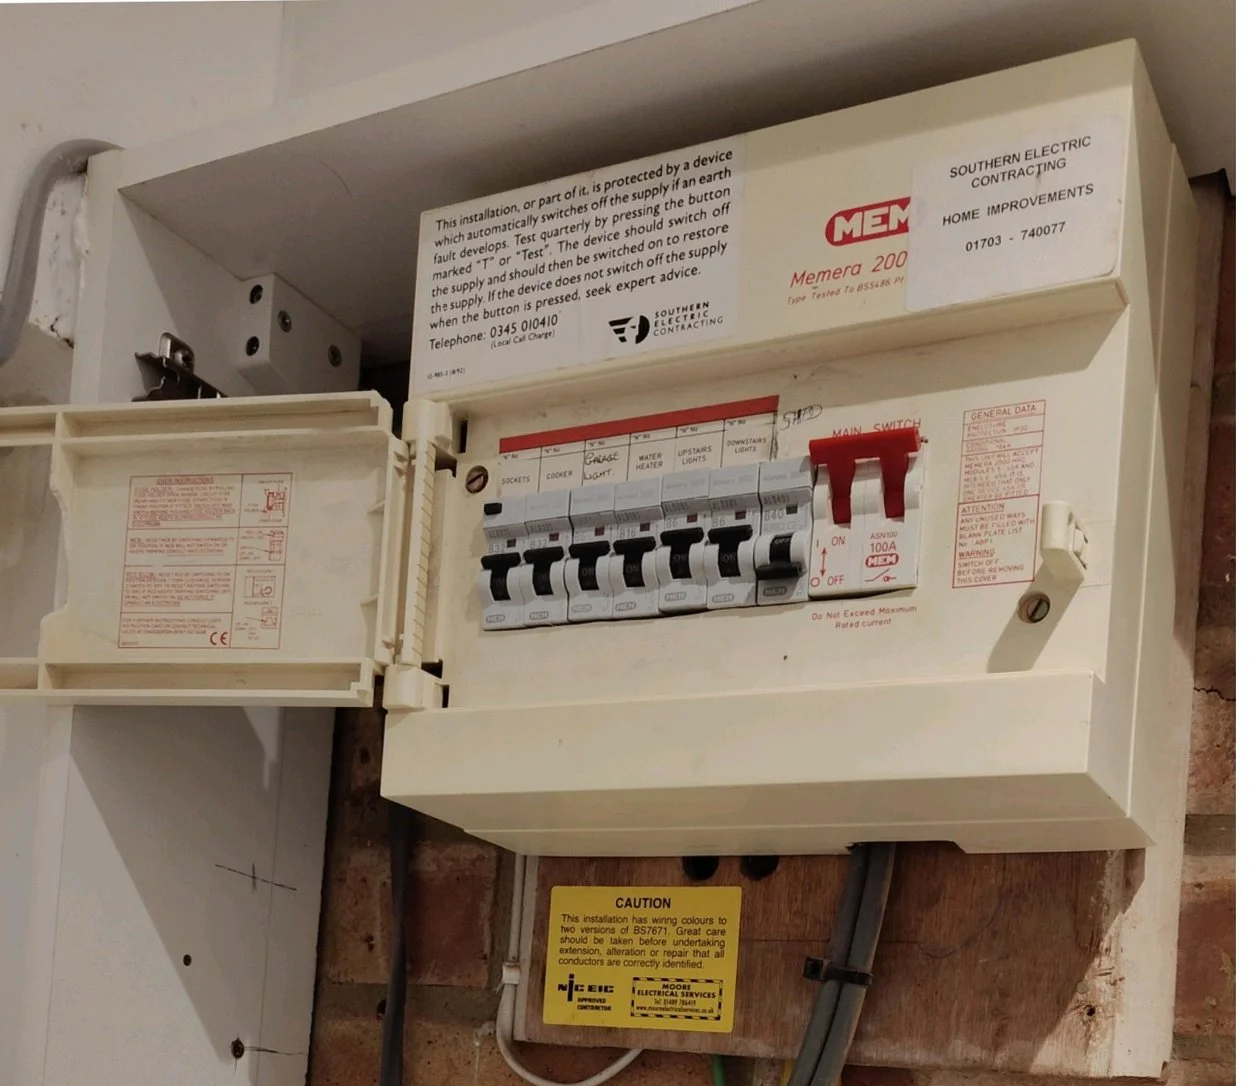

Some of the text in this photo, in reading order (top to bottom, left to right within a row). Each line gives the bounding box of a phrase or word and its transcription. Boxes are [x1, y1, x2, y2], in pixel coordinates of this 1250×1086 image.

[949, 136, 1090, 178] SOUTHERN ELECTRIC
[971, 157, 1066, 188] CONTRACTING
[435, 150, 733, 231] This installation, or part of it, is protected by a device
[434, 167, 731, 247] which automatically switches off the supply if an earth
[942, 183, 1094, 226] HOME IMPROVEMENTS
[433, 187, 730, 264] fault develops. Test quarterly by pressing the button
[833, 203, 910, 242] MEM
[965, 234, 1002, 252] 01703
[1021, 221, 1066, 240] 740077
[790, 263, 862, 287] Memera
[429, 313, 558, 350] Telephone: 0345 010410
[833, 418, 922, 438] MAIN SWITCH
[726, 437, 766, 446] DOWNSTAIRS
[678, 446, 712, 457] UPSTAIRS
[734, 445, 756, 454] LIGHTS
[638, 452, 662, 461] WATER
[681, 454, 706, 465] LIGHTS
[635, 460, 663, 470] HEATER
[501, 475, 530, 485] SOCKETS
[546, 470, 573, 480] COOKER
[831, 535, 845, 546] ON
[870, 540, 897, 553] 100A
[867, 555, 898, 567] MEM
[827, 574, 844, 586] OFF
[811, 605, 917, 621] Do Not Exceed Maximum
[834, 617, 892, 629] Rated current
[615, 897, 671, 909] CAUTION
[560, 913, 727, 927] This installation has wiring colours to
[560, 924, 726, 936] two versions of BS7671. Great care
[559, 934, 725, 949] should be taken before undertaking
[559, 945, 725, 959] extension, alteration or repair that all
[558, 956, 705, 970] conductors are correctly identified.
[661, 983, 691, 991] MOORE
[637, 989, 716, 999] ELECTRICAL SERVICES
